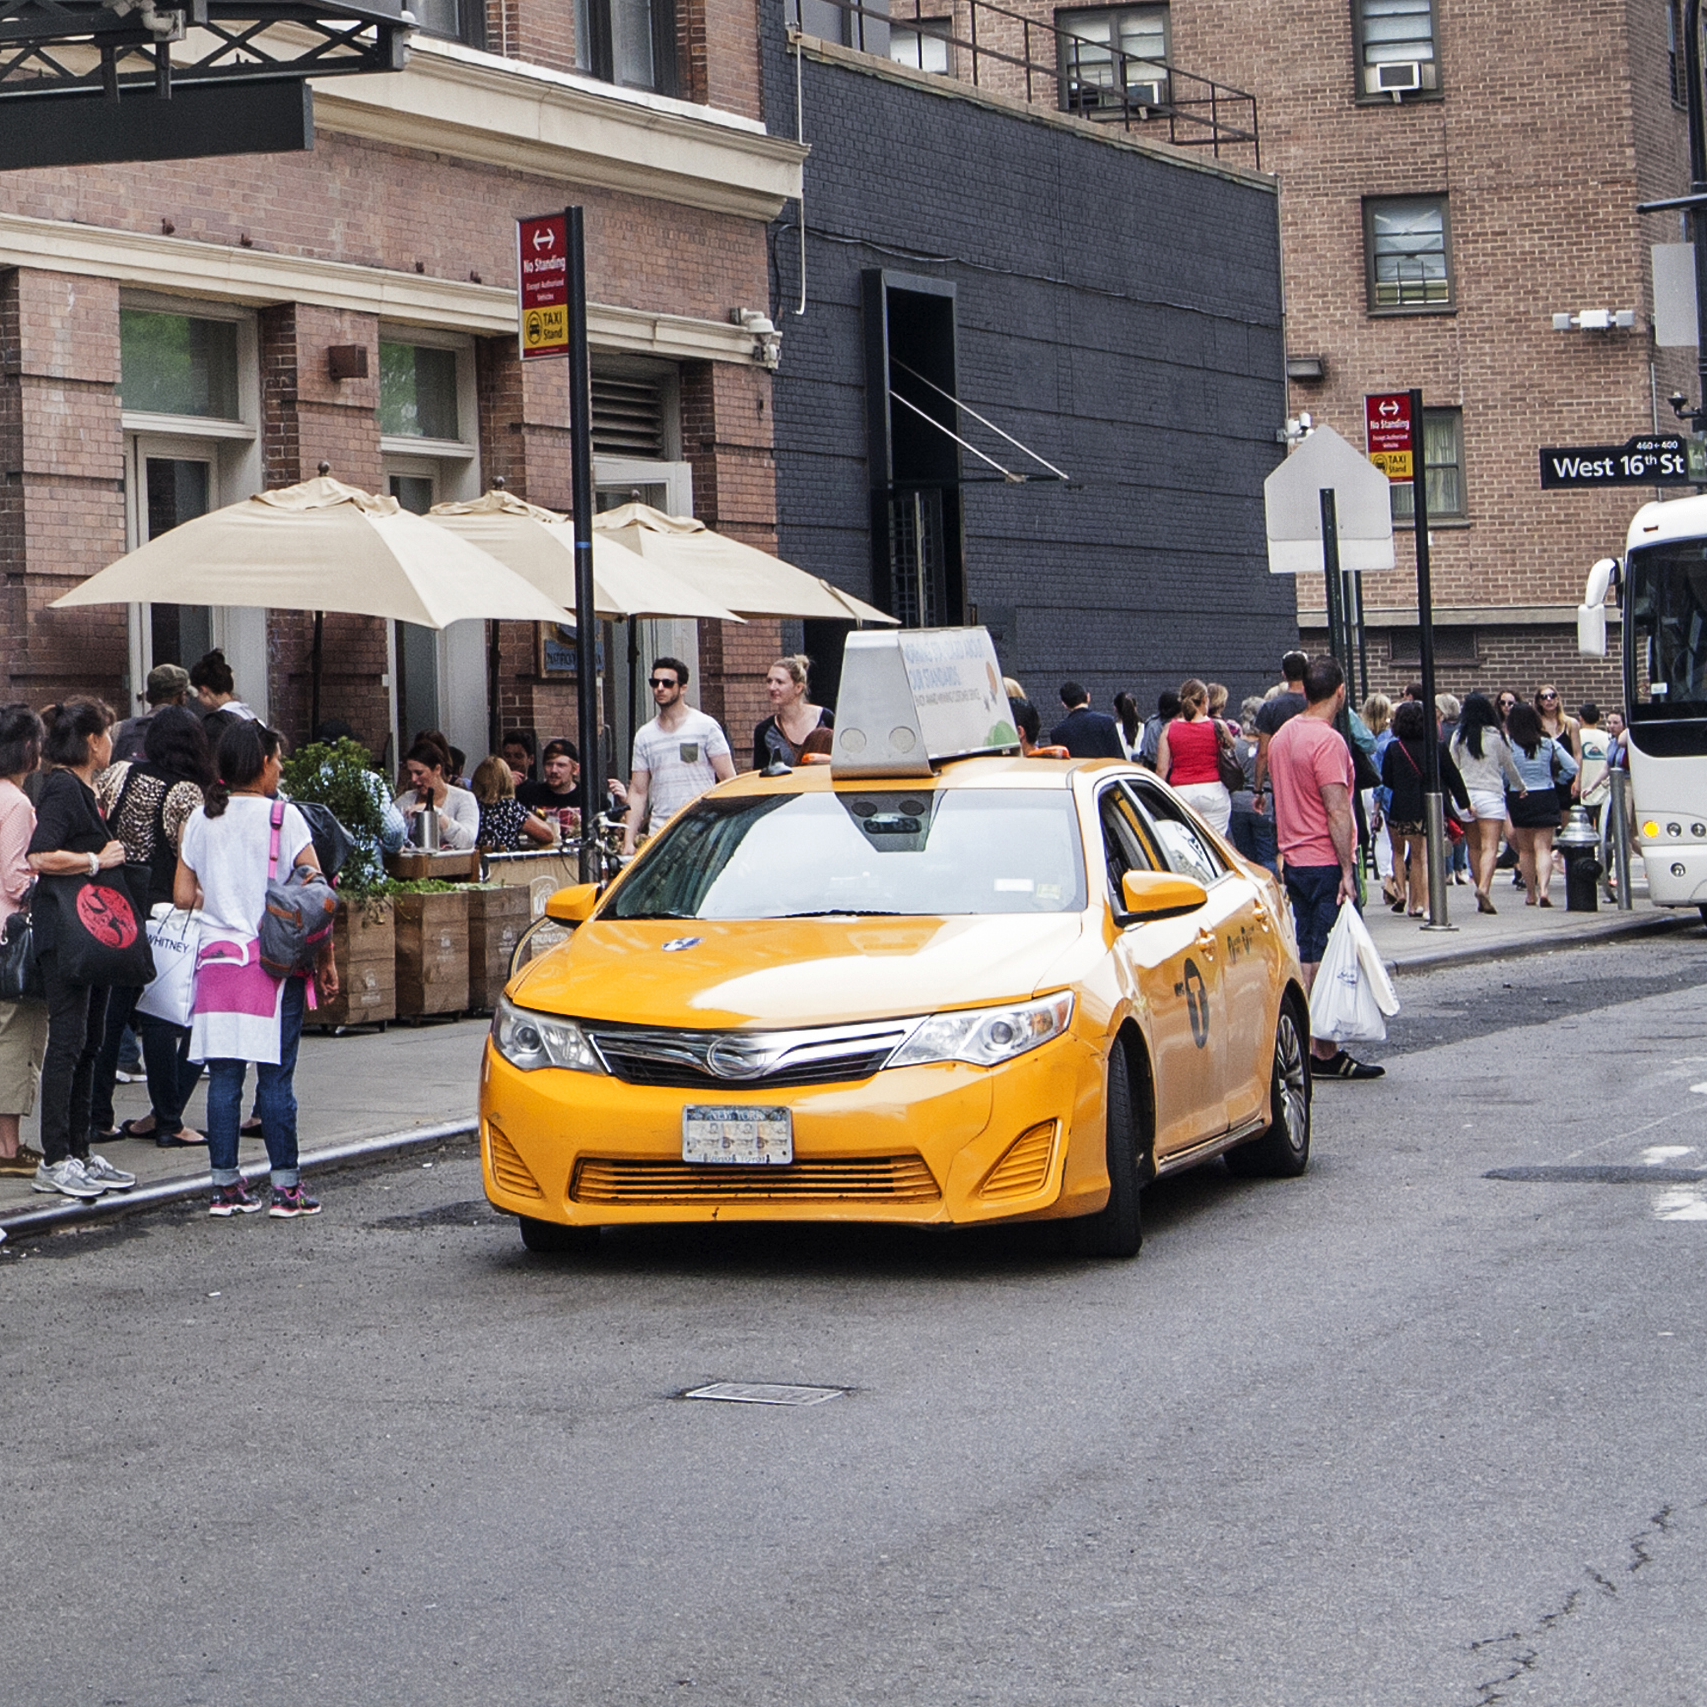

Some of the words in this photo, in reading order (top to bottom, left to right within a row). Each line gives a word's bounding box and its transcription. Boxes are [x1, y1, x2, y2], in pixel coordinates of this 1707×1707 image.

[524, 260, 534, 273] No
[535, 255, 566, 272] Standing
[543, 311, 563, 325] TAXI
[543, 327, 563, 340] Stand
[1370, 420, 1380, 430] No
[1381, 418, 1410, 431] Standing
[1388, 455, 1407, 464] TAXI
[1552, 457, 1615, 478] West
[1620, 454, 1657, 476] 16th
[1660, 453, 1684, 474] St
[1389, 464, 1407, 474] Stand
[148, 934, 190, 954] WHITNEY
